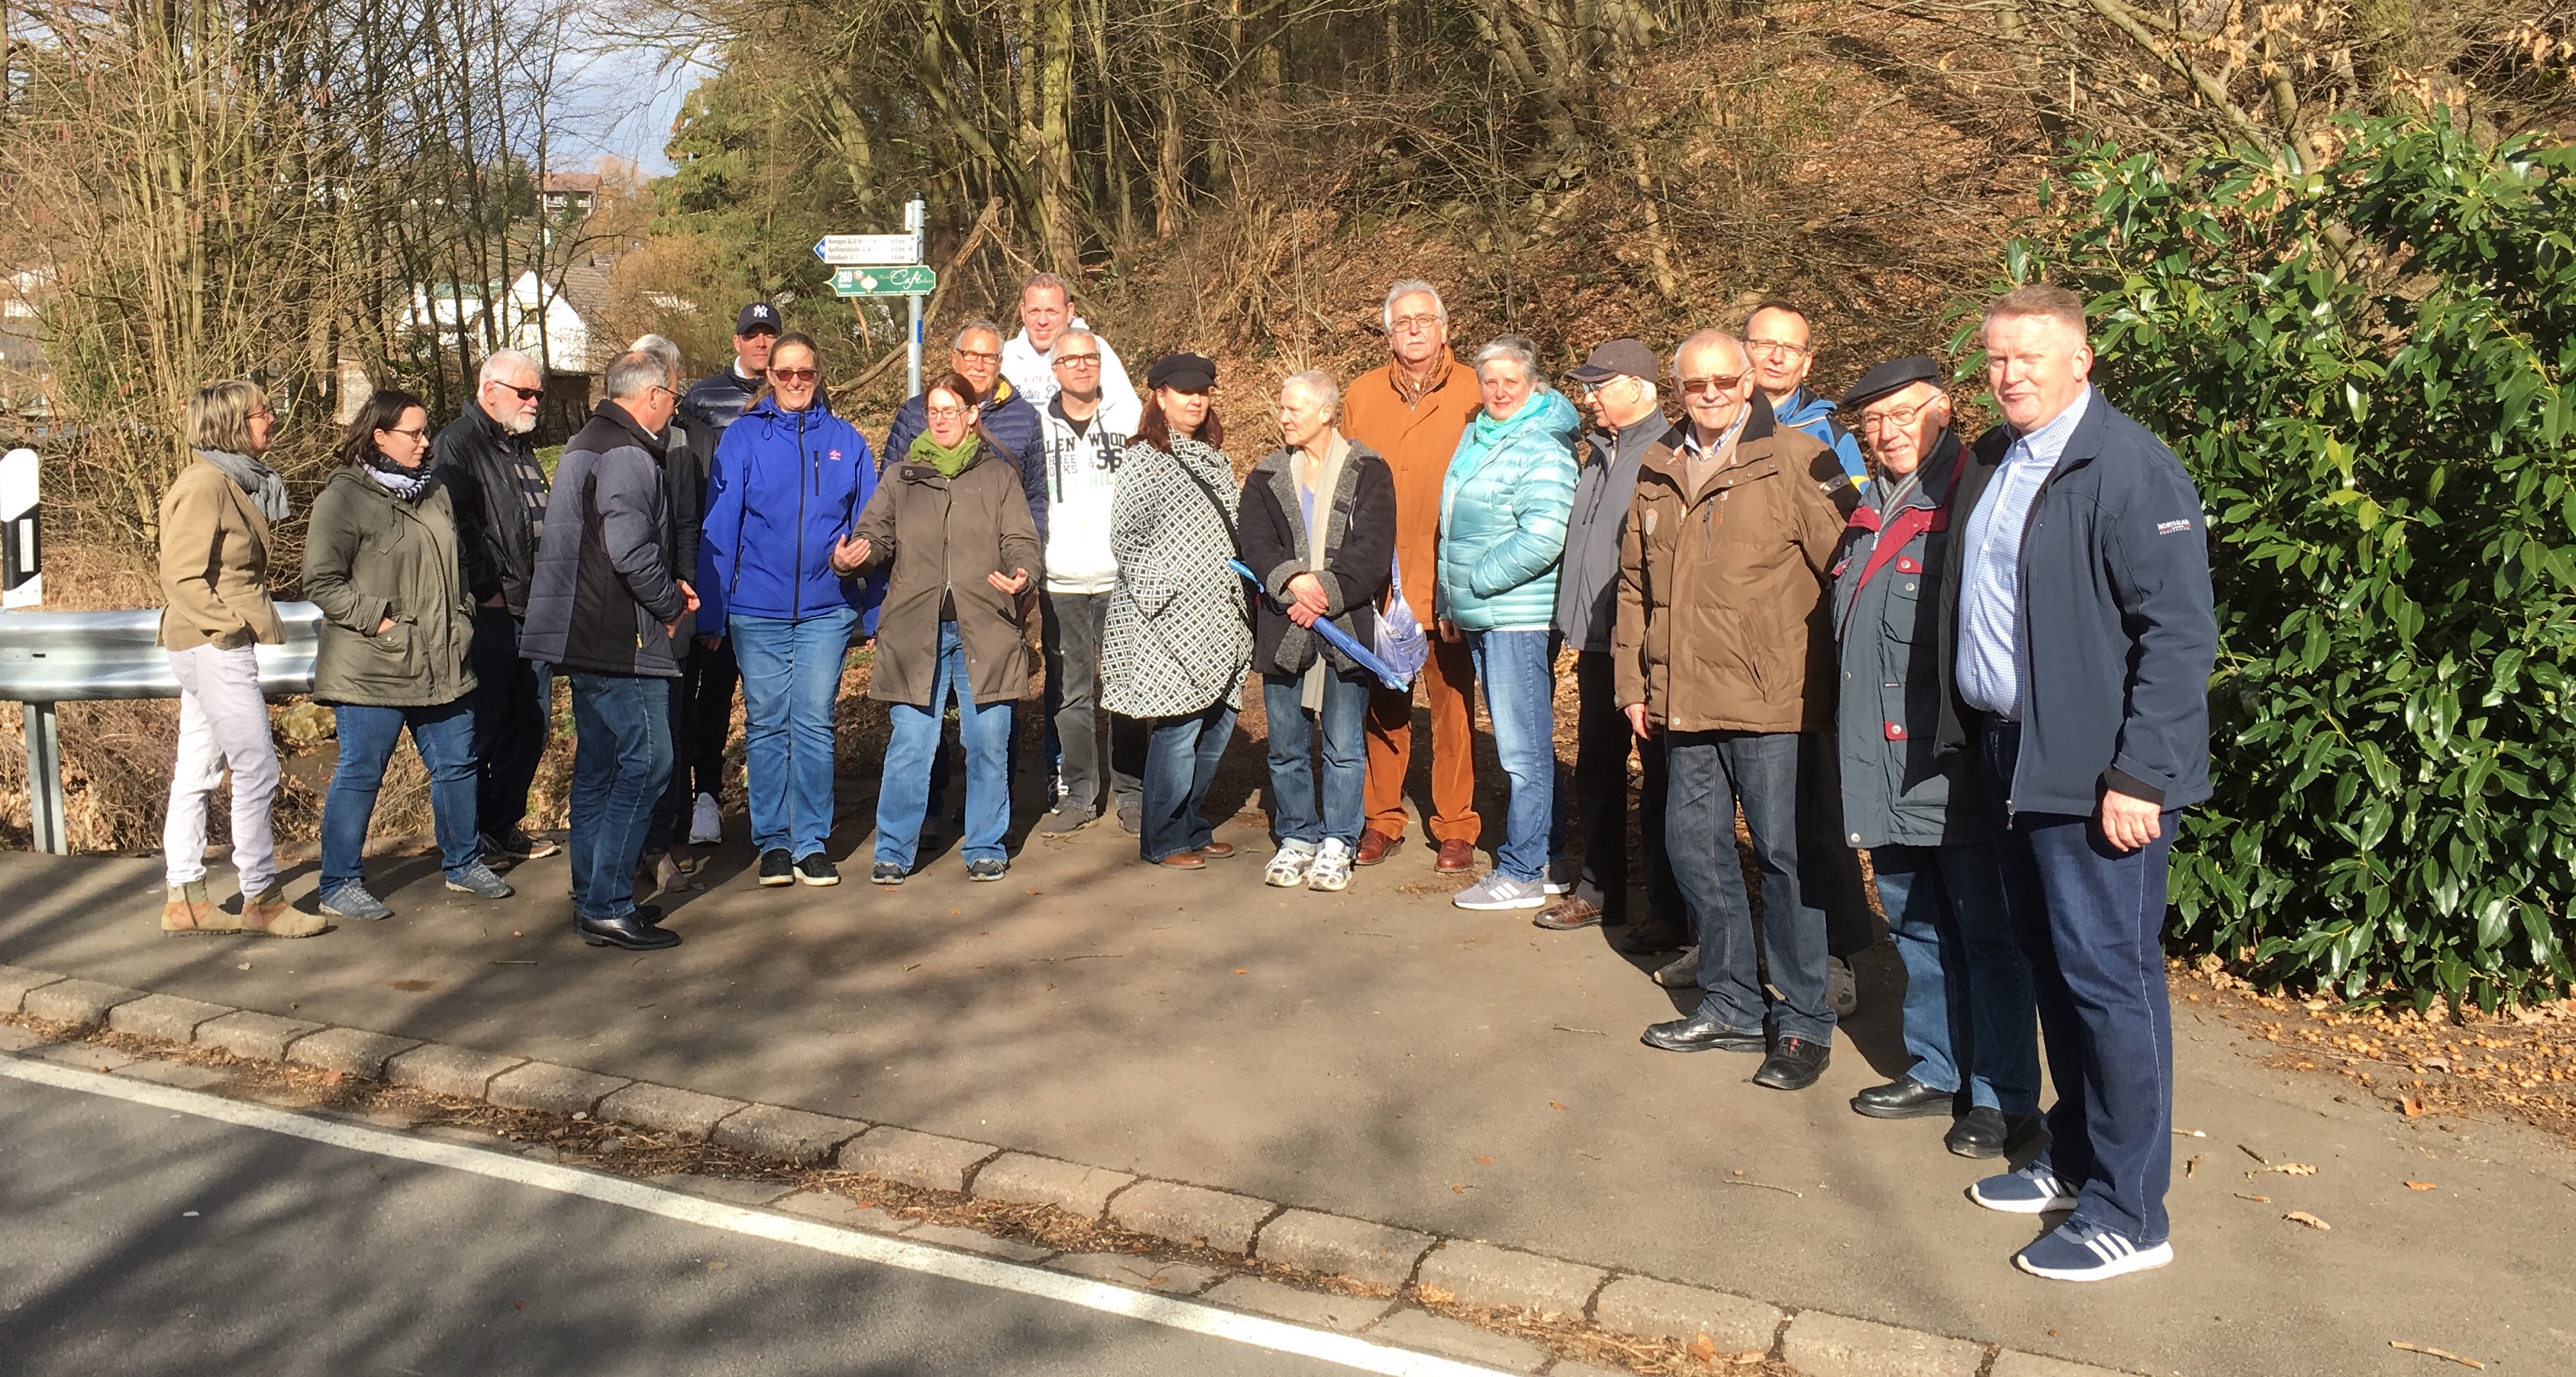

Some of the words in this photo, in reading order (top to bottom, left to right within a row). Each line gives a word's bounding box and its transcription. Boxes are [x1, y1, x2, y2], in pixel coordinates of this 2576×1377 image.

[838, 271, 853, 283] 260
[891, 269, 922, 290] Café
[754, 304, 769, 318] NY
[1045, 384, 1059, 400] D
[1045, 436, 1076, 454] LEN
[1048, 454, 1077, 466] HEE
[1096, 448, 1123, 470] 56
[1048, 464, 1078, 477] OKS
[1089, 470, 1114, 488] HIL
[2156, 519, 2191, 530] NORTHLAN
